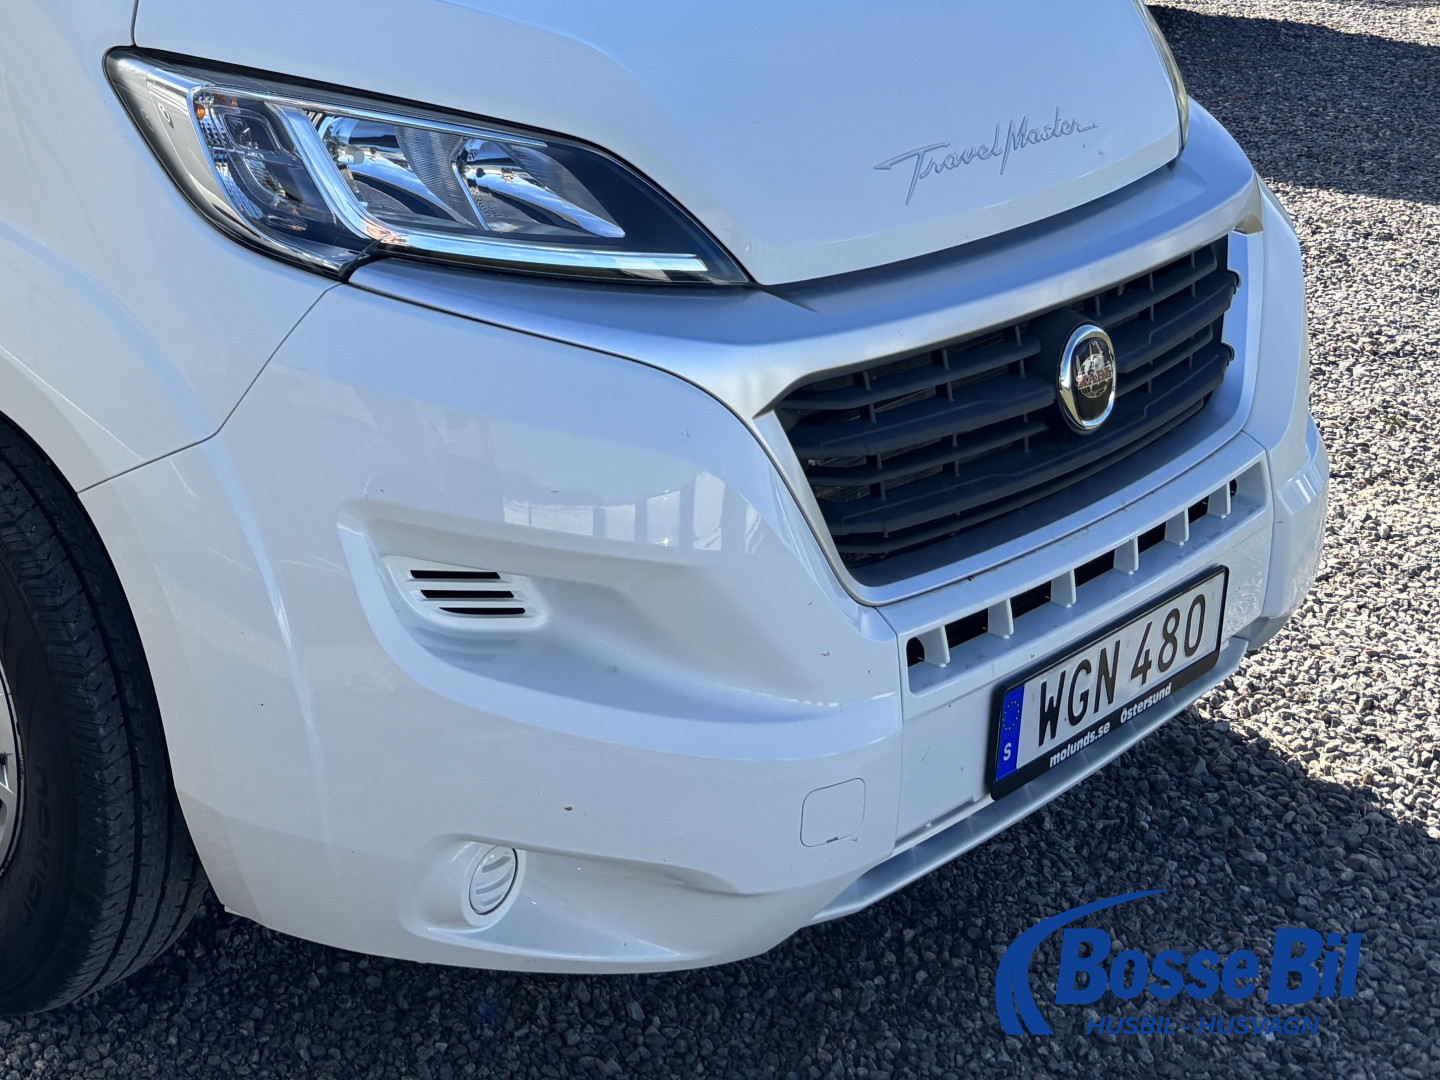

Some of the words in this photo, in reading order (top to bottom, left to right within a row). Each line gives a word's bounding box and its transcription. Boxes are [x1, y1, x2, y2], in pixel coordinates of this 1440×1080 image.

[1038, 639, 1121, 748] WGN
[1130, 594, 1206, 686] 480
[1003, 742, 1012, 762] S
[1049, 721, 1110, 768] molunds.se
